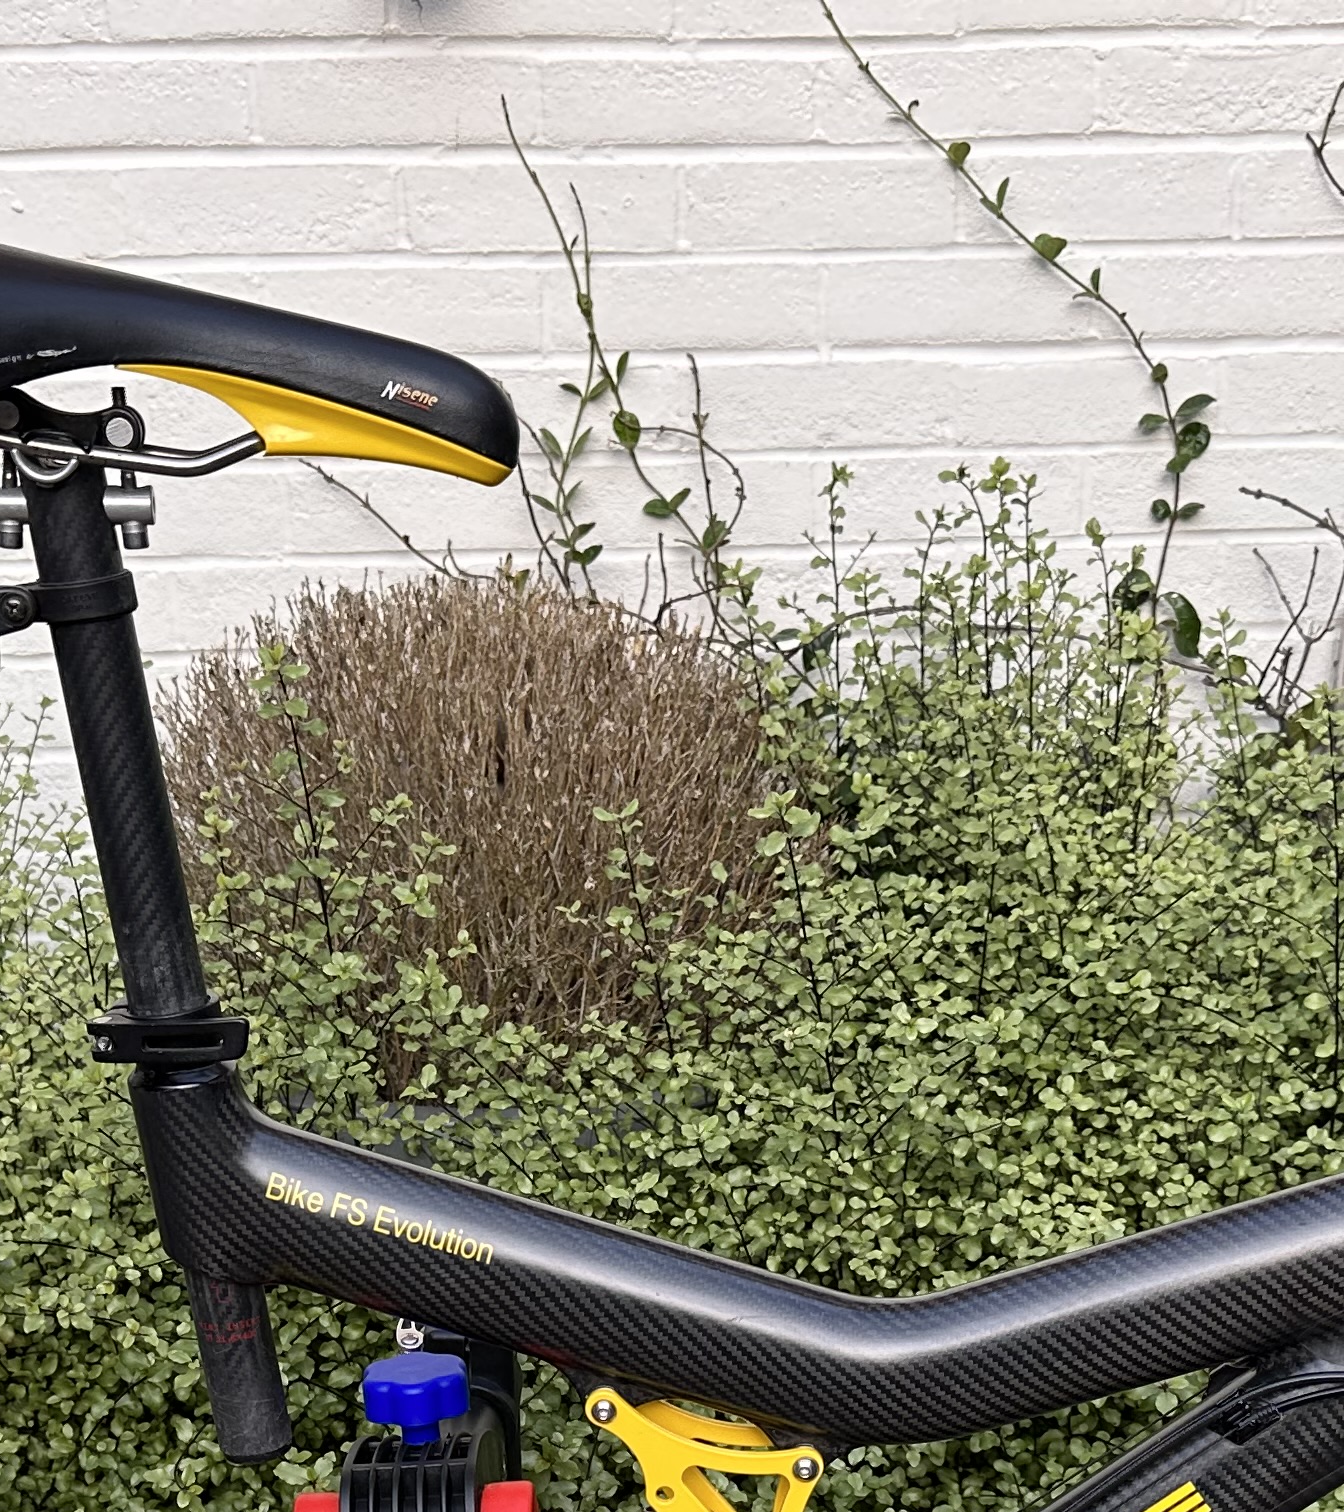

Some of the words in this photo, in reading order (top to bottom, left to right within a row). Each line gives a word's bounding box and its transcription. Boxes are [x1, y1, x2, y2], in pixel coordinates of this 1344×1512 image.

[381, 381, 438, 407] Nisene
[265, 1172, 323, 1213] Bike
[330, 1193, 368, 1226] FS
[373, 1206, 494, 1265] Evolution
